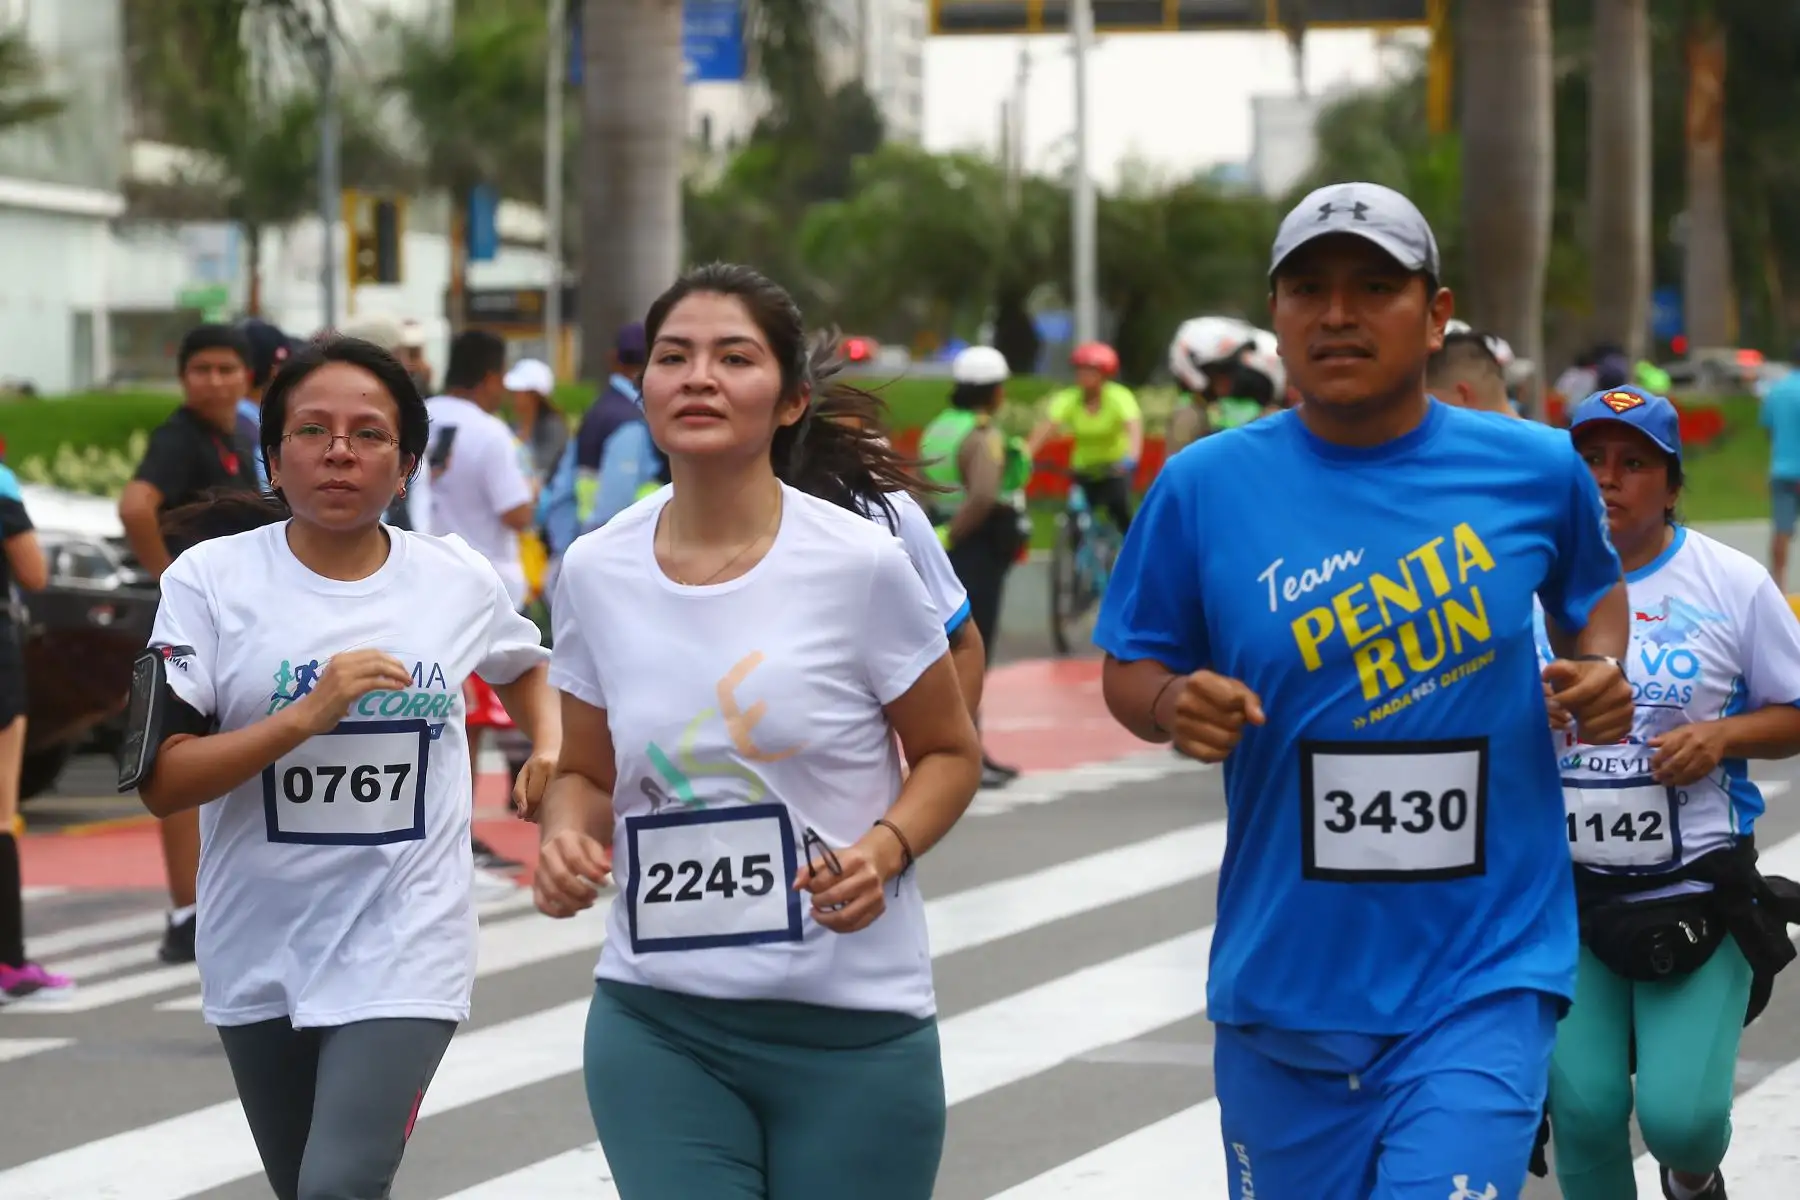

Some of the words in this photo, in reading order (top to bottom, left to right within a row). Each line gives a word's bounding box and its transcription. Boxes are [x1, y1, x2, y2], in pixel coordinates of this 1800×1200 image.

[1257, 547, 1364, 612] Team
[1290, 521, 1496, 673] PENTA
[1352, 585, 1492, 702] RUN
[1640, 648, 1699, 680] VO
[1632, 681, 1693, 705] OGAS
[282, 763, 412, 804] 0767
[1588, 756, 1656, 774] DEVI
[1323, 788, 1468, 834] 3430
[1566, 810, 1664, 843] 1142
[643, 853, 775, 904] 2245
